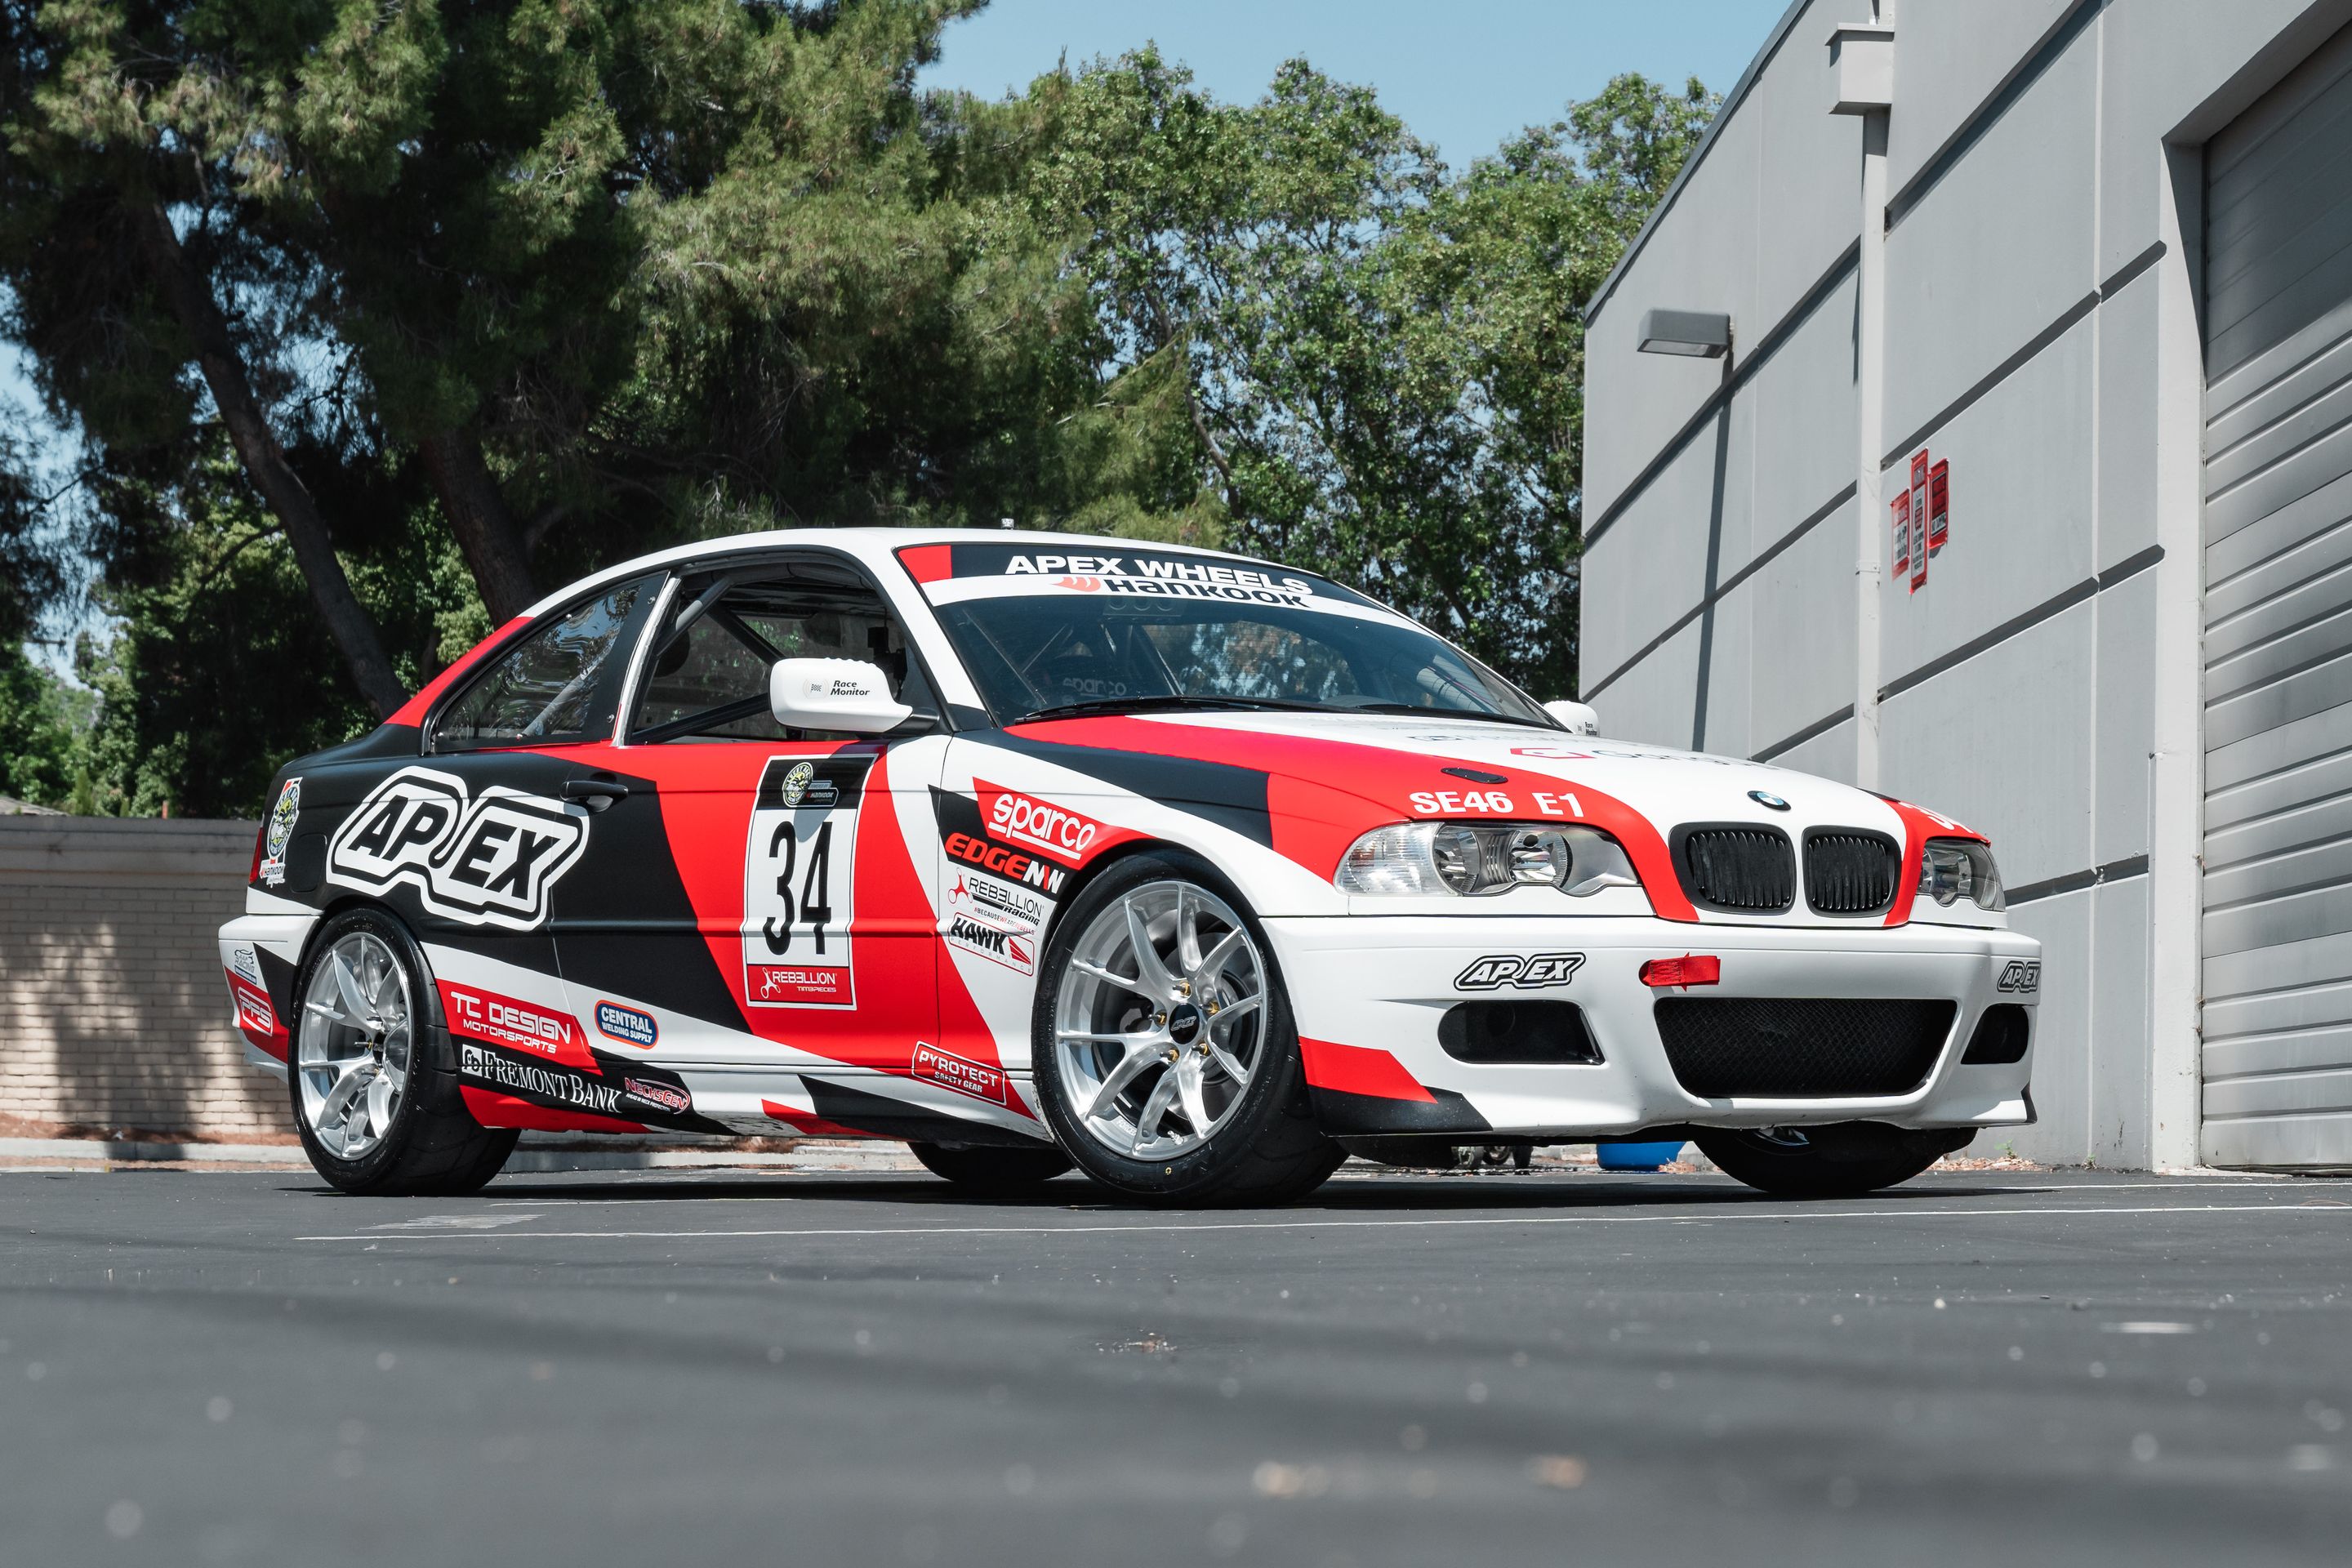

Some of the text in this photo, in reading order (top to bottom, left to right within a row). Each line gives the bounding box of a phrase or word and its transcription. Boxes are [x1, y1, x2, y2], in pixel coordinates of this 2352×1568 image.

[1004, 555, 1313, 595] APEX WHEELS
[830, 688, 870, 696] Monitor
[833, 679, 858, 688] Race
[1409, 791, 1584, 817] SE46 E1
[993, 794, 1096, 852] sparco
[345, 792, 563, 902] APEX
[763, 821, 833, 956] 34
[969, 877, 1042, 918] REBELLION
[951, 916, 1008, 956] HAWK
[234, 957, 255, 973] RACING
[772, 971, 836, 985] REBELLION
[1463, 958, 1577, 985] APEX
[2002, 966, 2040, 987] APEX
[451, 991, 571, 1045] TC DESIGN
[601, 1007, 653, 1034] CENTRAL
[601, 1022, 653, 1043] WELDING SUPPLY
[463, 1018, 557, 1054] MOTORSPORTS
[483, 1049, 568, 1100] FREMONT
[568, 1074, 622, 1114] BANK
[919, 1050, 998, 1087] PYROTECT
[934, 1071, 983, 1093] SAFETY GEAR
